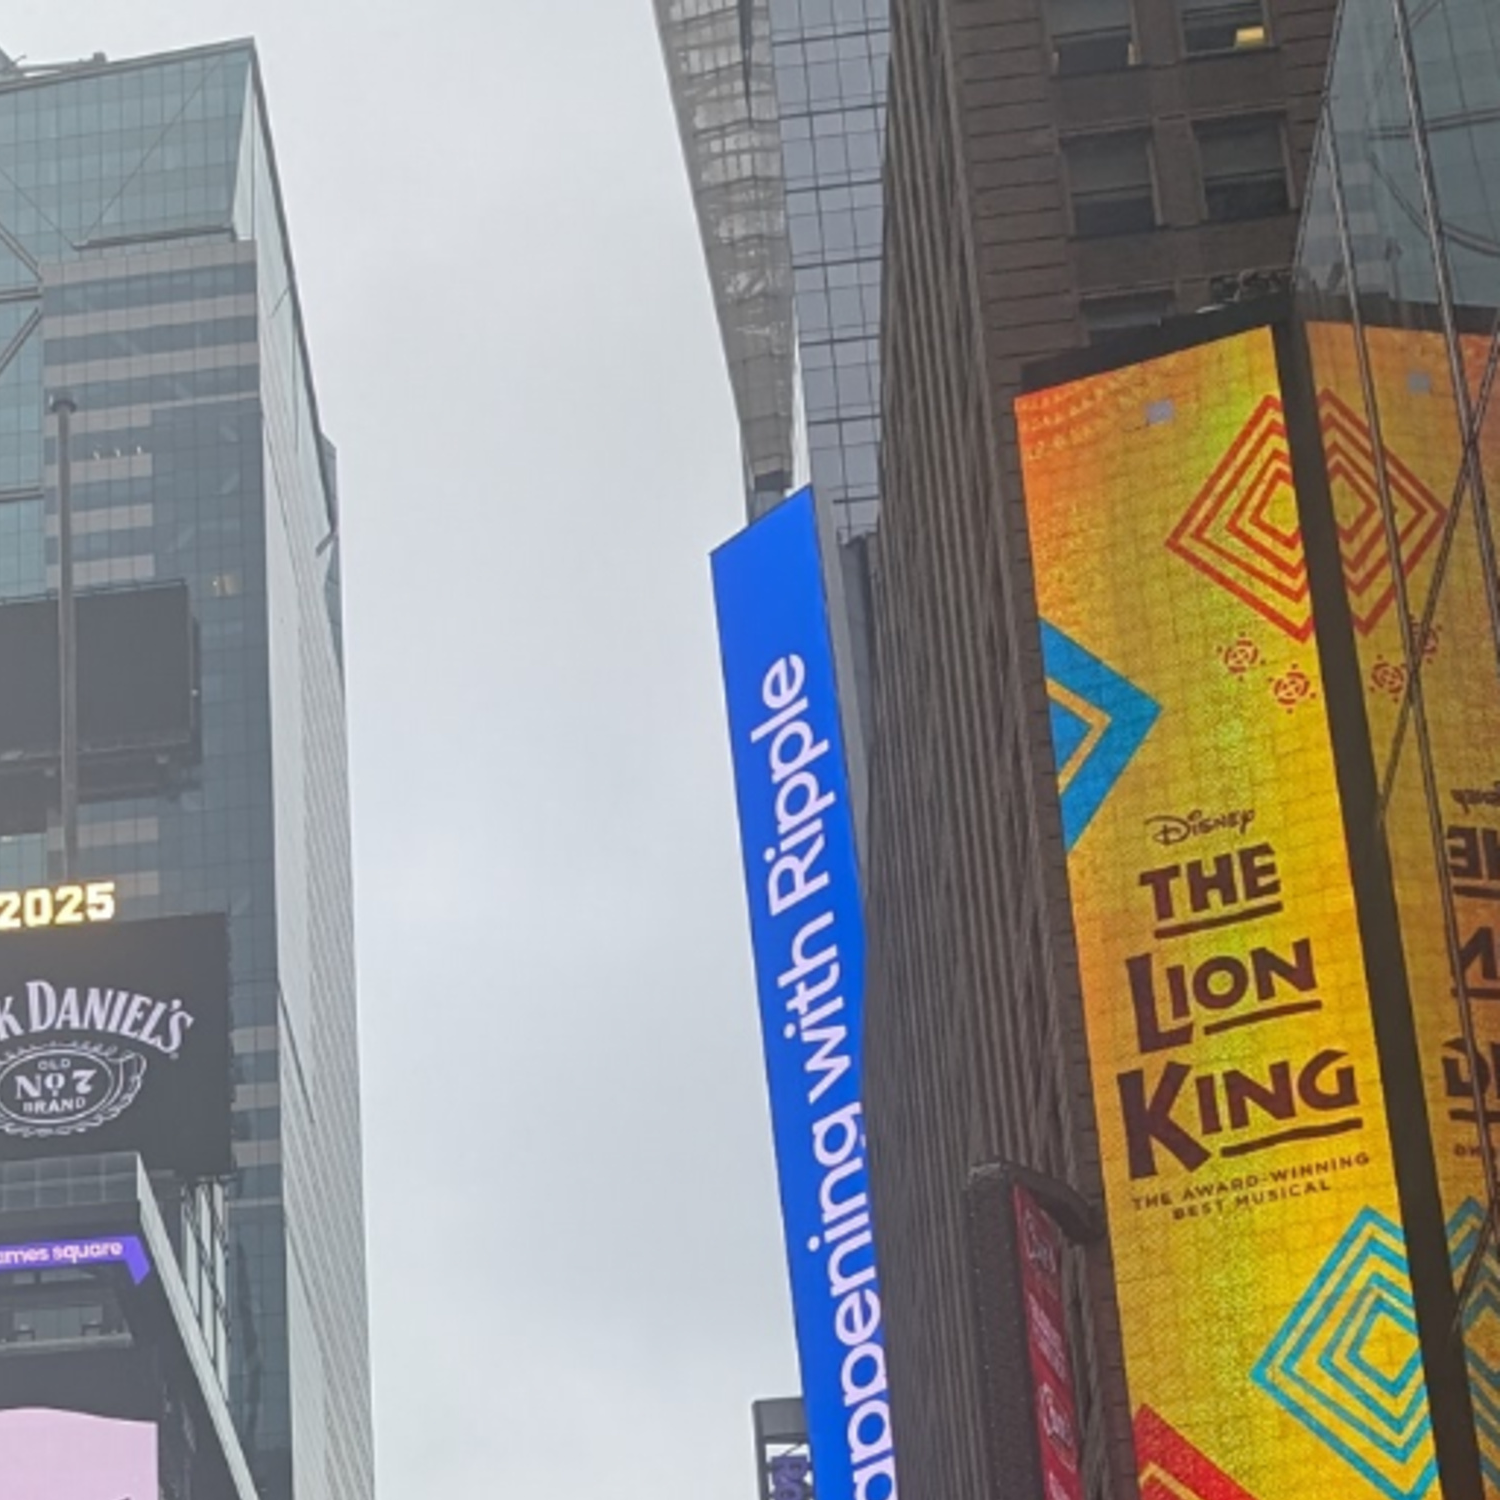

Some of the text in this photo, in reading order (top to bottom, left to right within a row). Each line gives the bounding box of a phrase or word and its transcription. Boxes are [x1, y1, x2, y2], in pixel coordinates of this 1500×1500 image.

[750, 653, 836, 917] Ripple
[1144, 808, 1256, 846] Disney
[1138, 841, 1282, 921] THE
[25, 979, 194, 1054] DANIEL'S
[777, 910, 851, 1105] with
[1125, 937, 1318, 1054] LION
[37, 1057, 71, 1071] OLD
[22, 1095, 86, 1114] BRAND
[1116, 1048, 1360, 1181] KING
[1132, 1151, 1371, 1212] THE AWARD-WINNING
[1173, 1181, 1332, 1221] BEST MUSICAL
[52, 1241, 124, 1264] square
